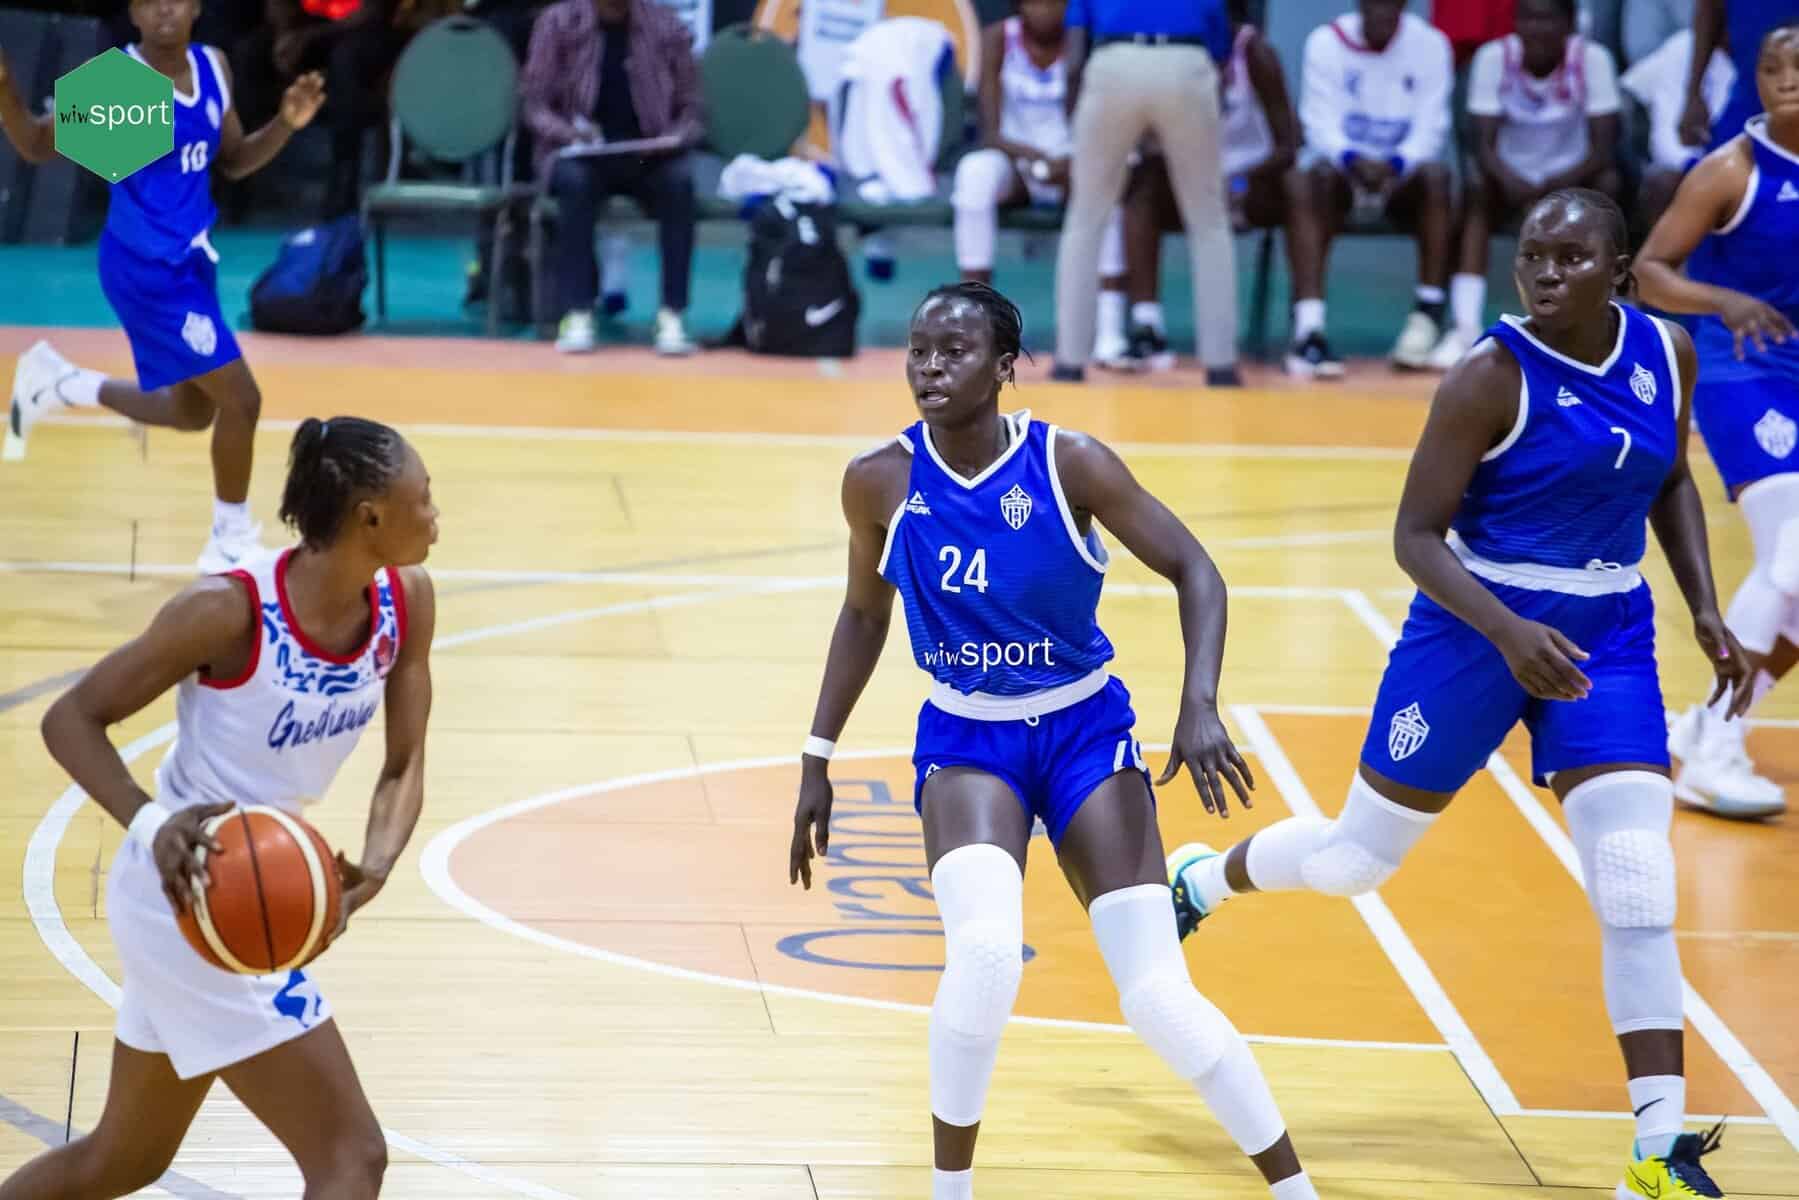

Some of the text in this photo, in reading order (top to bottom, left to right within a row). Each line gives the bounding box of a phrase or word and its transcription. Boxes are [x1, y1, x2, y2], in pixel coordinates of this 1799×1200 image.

[180, 140, 209, 174] 10
[1610, 426, 1632, 470] 7
[938, 545, 989, 594] 24
